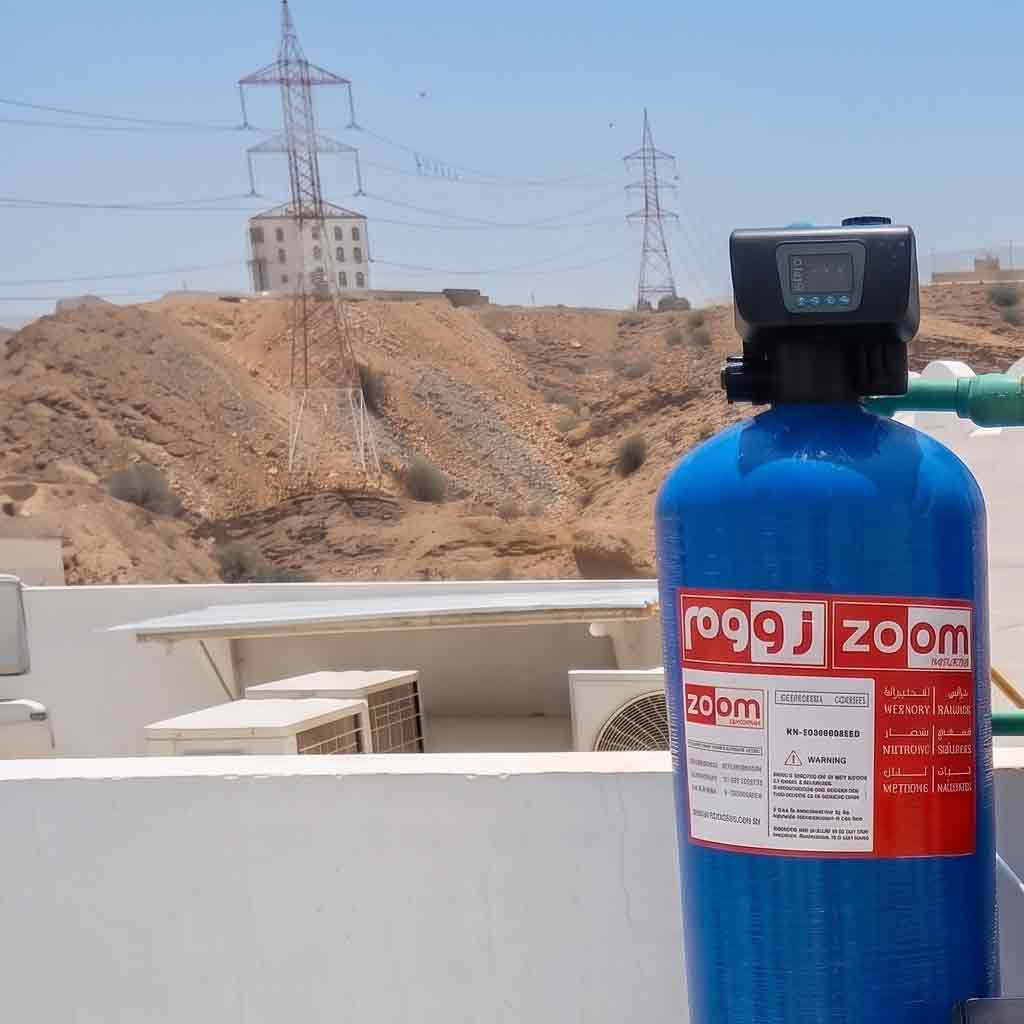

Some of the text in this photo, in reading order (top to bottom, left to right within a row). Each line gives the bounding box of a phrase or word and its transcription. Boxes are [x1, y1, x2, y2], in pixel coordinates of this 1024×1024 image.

[842, 619, 970, 655] zoom
[687, 694, 761, 719] zoom
[808, 757, 847, 765] WARNING
